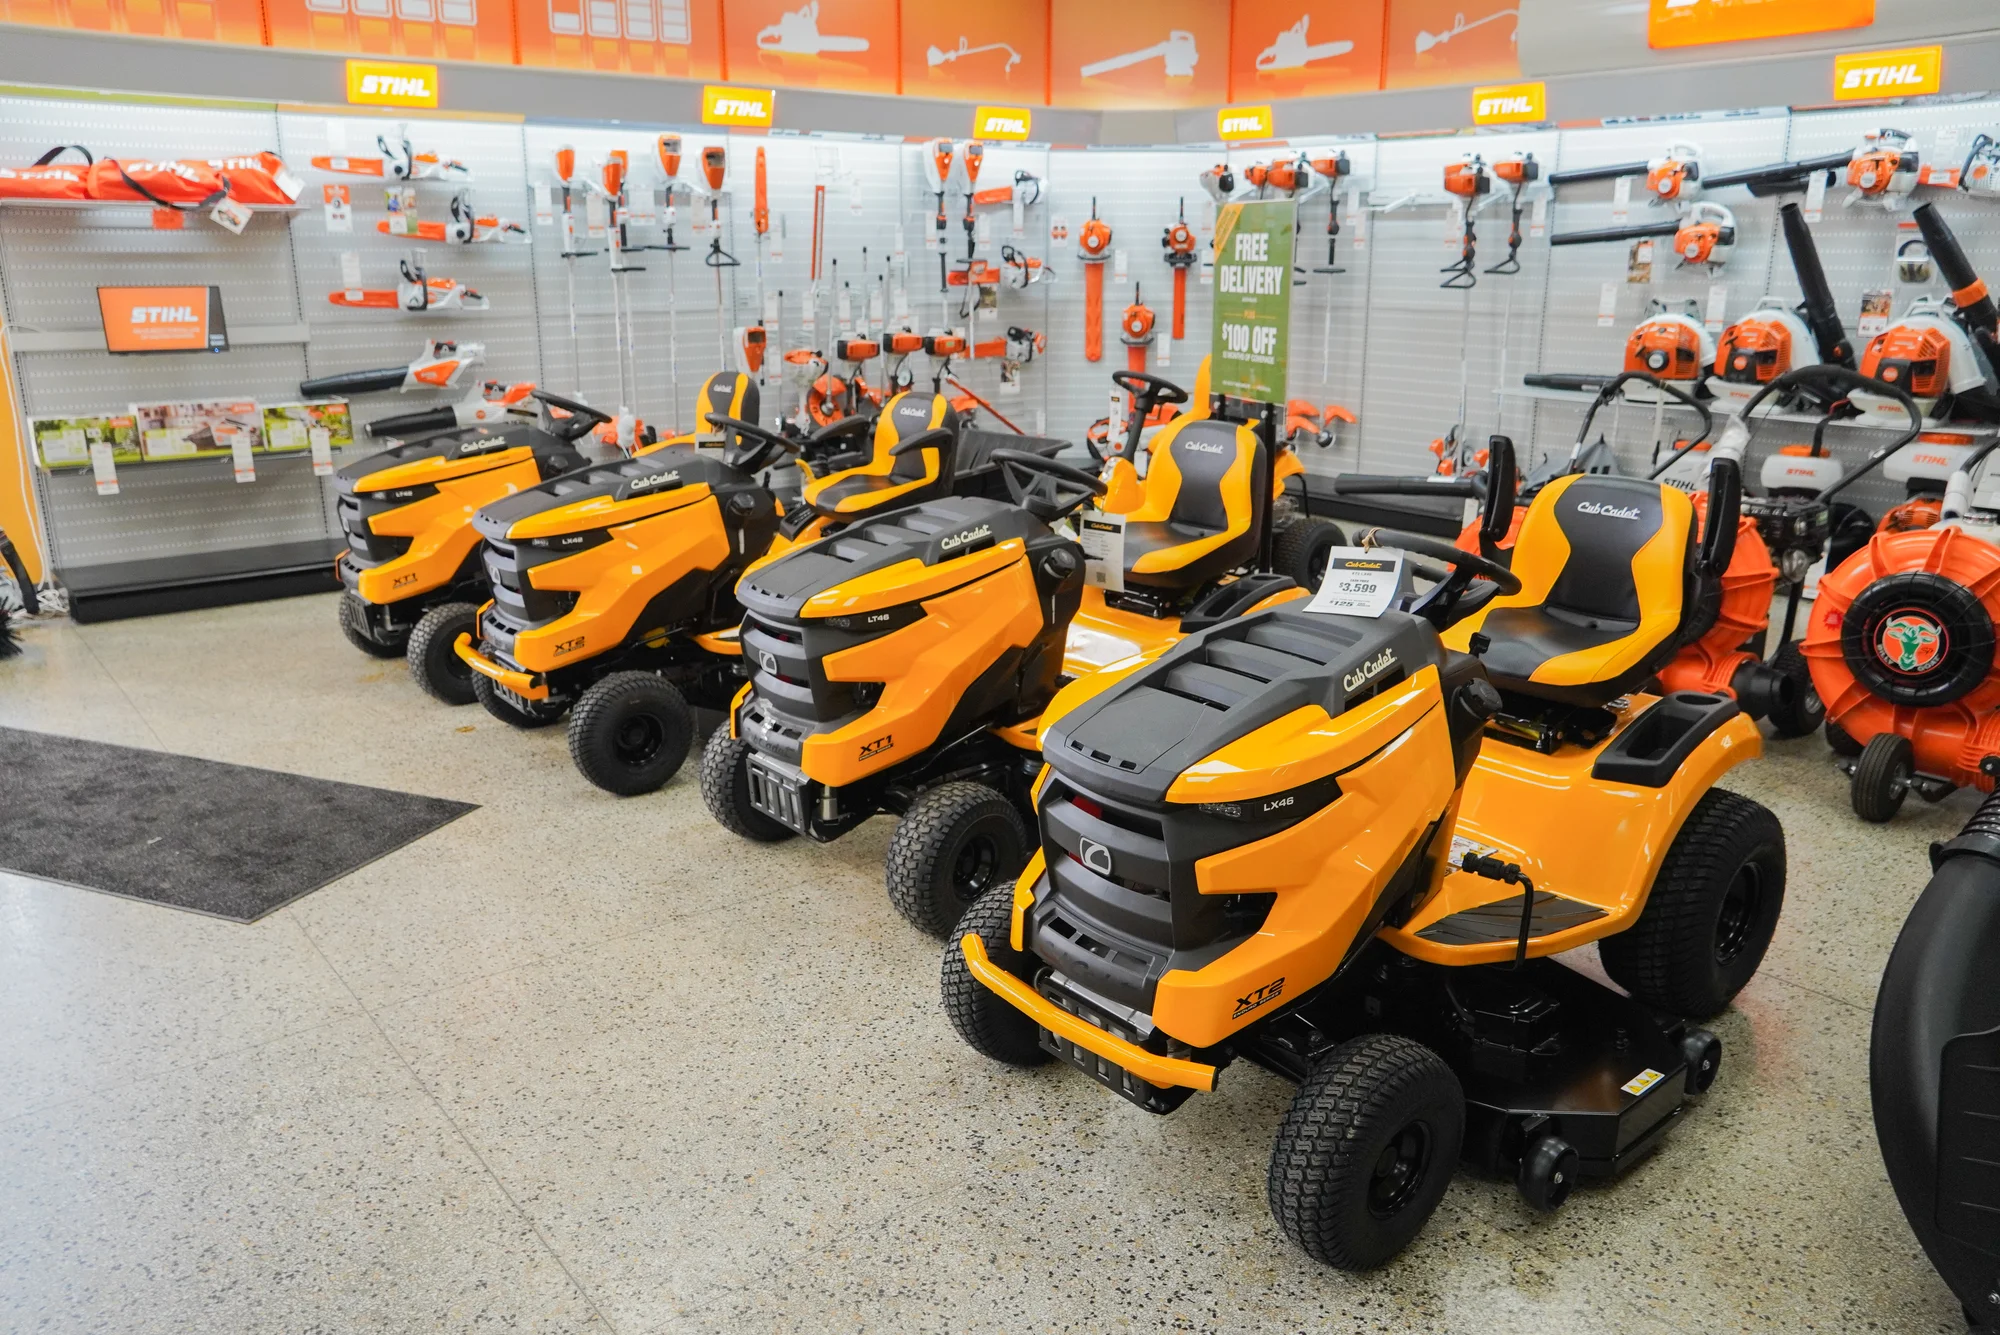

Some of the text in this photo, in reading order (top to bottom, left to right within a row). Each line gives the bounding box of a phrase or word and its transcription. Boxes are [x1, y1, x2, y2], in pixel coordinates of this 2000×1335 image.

[360, 74, 431, 97] STIHL
[1842, 64, 1924, 89] STIHL
[713, 99, 767, 118] STIHL
[1477, 96, 1533, 116] STIHL
[983, 117, 1026, 133] STIHL
[1222, 116, 1263, 133] STIHL
[1235, 233, 1269, 262] FREE
[1220, 265, 1283, 295] DELIVERY
[131, 306, 199, 324] STIHL
[1222, 322, 1277, 355] $100 OFF
[1877, 405, 1904, 413] STIHL
[1912, 454, 1948, 466] STIHL
[631, 470, 679, 489] Cub Cadet
[1786, 468, 1816, 477] STIHL
[1663, 477, 1697, 491] STIHL
[1577, 501, 1640, 520] Cub Cadet
[941, 524, 992, 550] Cub Cadet
[1339, 582, 1377, 594] $3,599
[1877, 643, 1895, 665] BILLY
[1917, 655, 1940, 671] GOAT
[1343, 648, 1396, 692] Cub Cadet
[860, 734, 892, 756] XT1
[1263, 797, 1294, 811] LX46
[1234, 977, 1286, 1012] XT2
